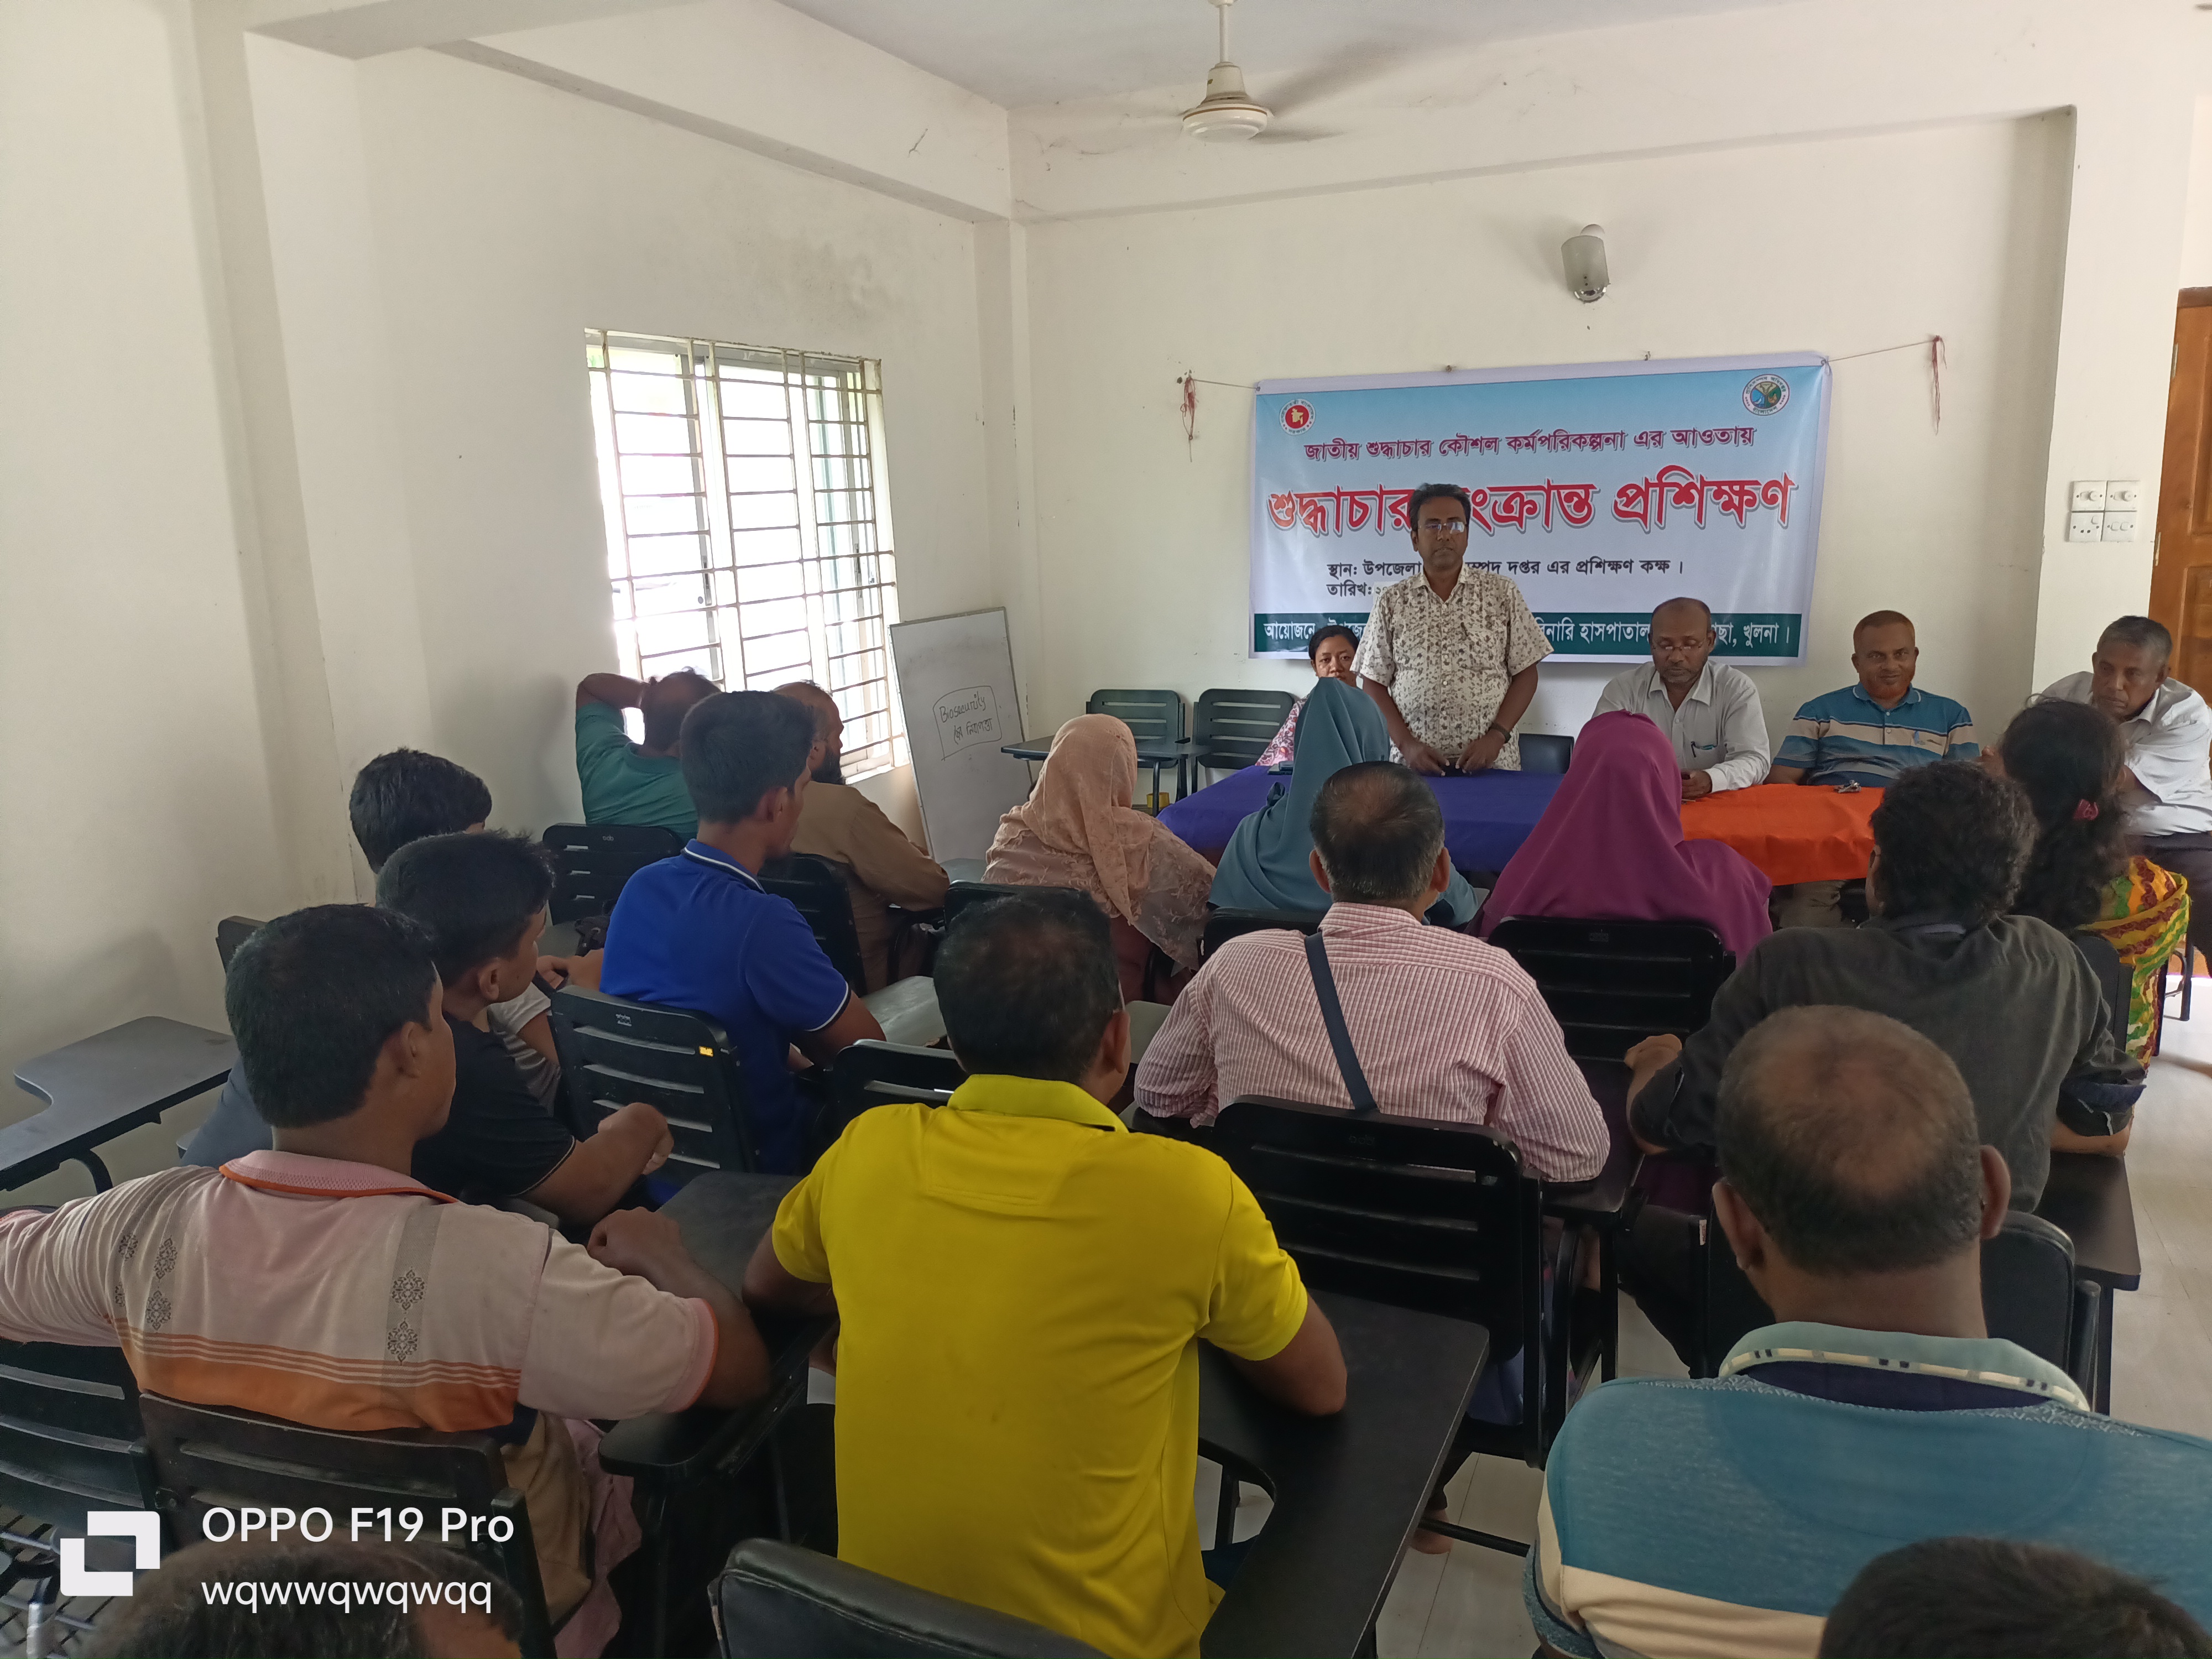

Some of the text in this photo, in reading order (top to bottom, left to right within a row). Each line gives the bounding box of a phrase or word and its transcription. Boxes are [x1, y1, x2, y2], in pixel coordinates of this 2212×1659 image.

[1303, 425, 1755, 460] জাতীয় শুদ্ধাচার কৌশল কর্মপরিকল্পনা এর আওতায়
[1462, 478, 1598, 532] ংক্রান্ত
[1613, 465, 1796, 533] প্রশিক্ষণ
[1362, 559, 1422, 576] উপজেলা
[1506, 560, 1541, 575] দপ্তর
[1547, 560, 1571, 575] এর
[1575, 555, 1634, 576] প্রশিক্ষণ
[1639, 559, 1671, 575] কক্ষ
[1743, 622, 1780, 648] খুলনা
[939, 690, 987, 723] Biosecurity
